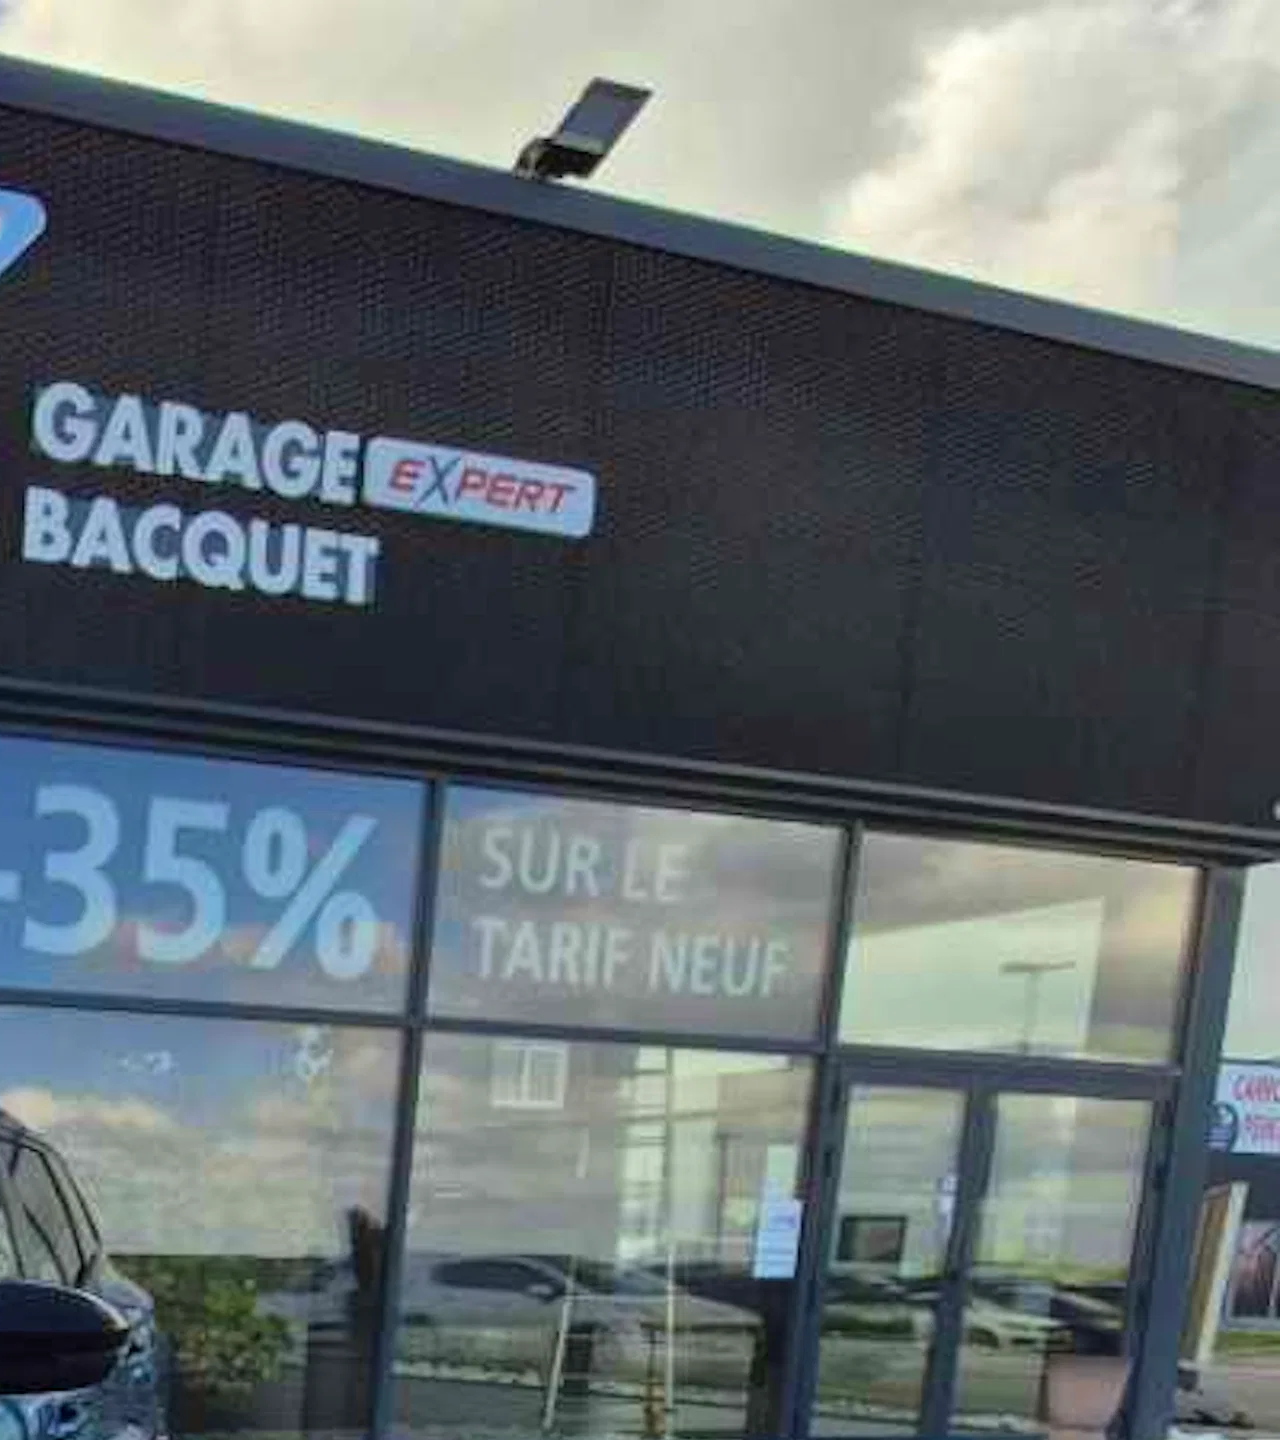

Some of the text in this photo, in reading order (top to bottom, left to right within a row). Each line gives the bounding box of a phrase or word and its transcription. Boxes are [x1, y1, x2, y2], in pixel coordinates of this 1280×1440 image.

[31, 381, 360, 505] GARAGE
[388, 456, 576, 514] EXPERT
[22, 485, 380, 604] BACQUET
[480, 824, 689, 901] SUR LE
[471, 915, 792, 998] TARIF NEUF
